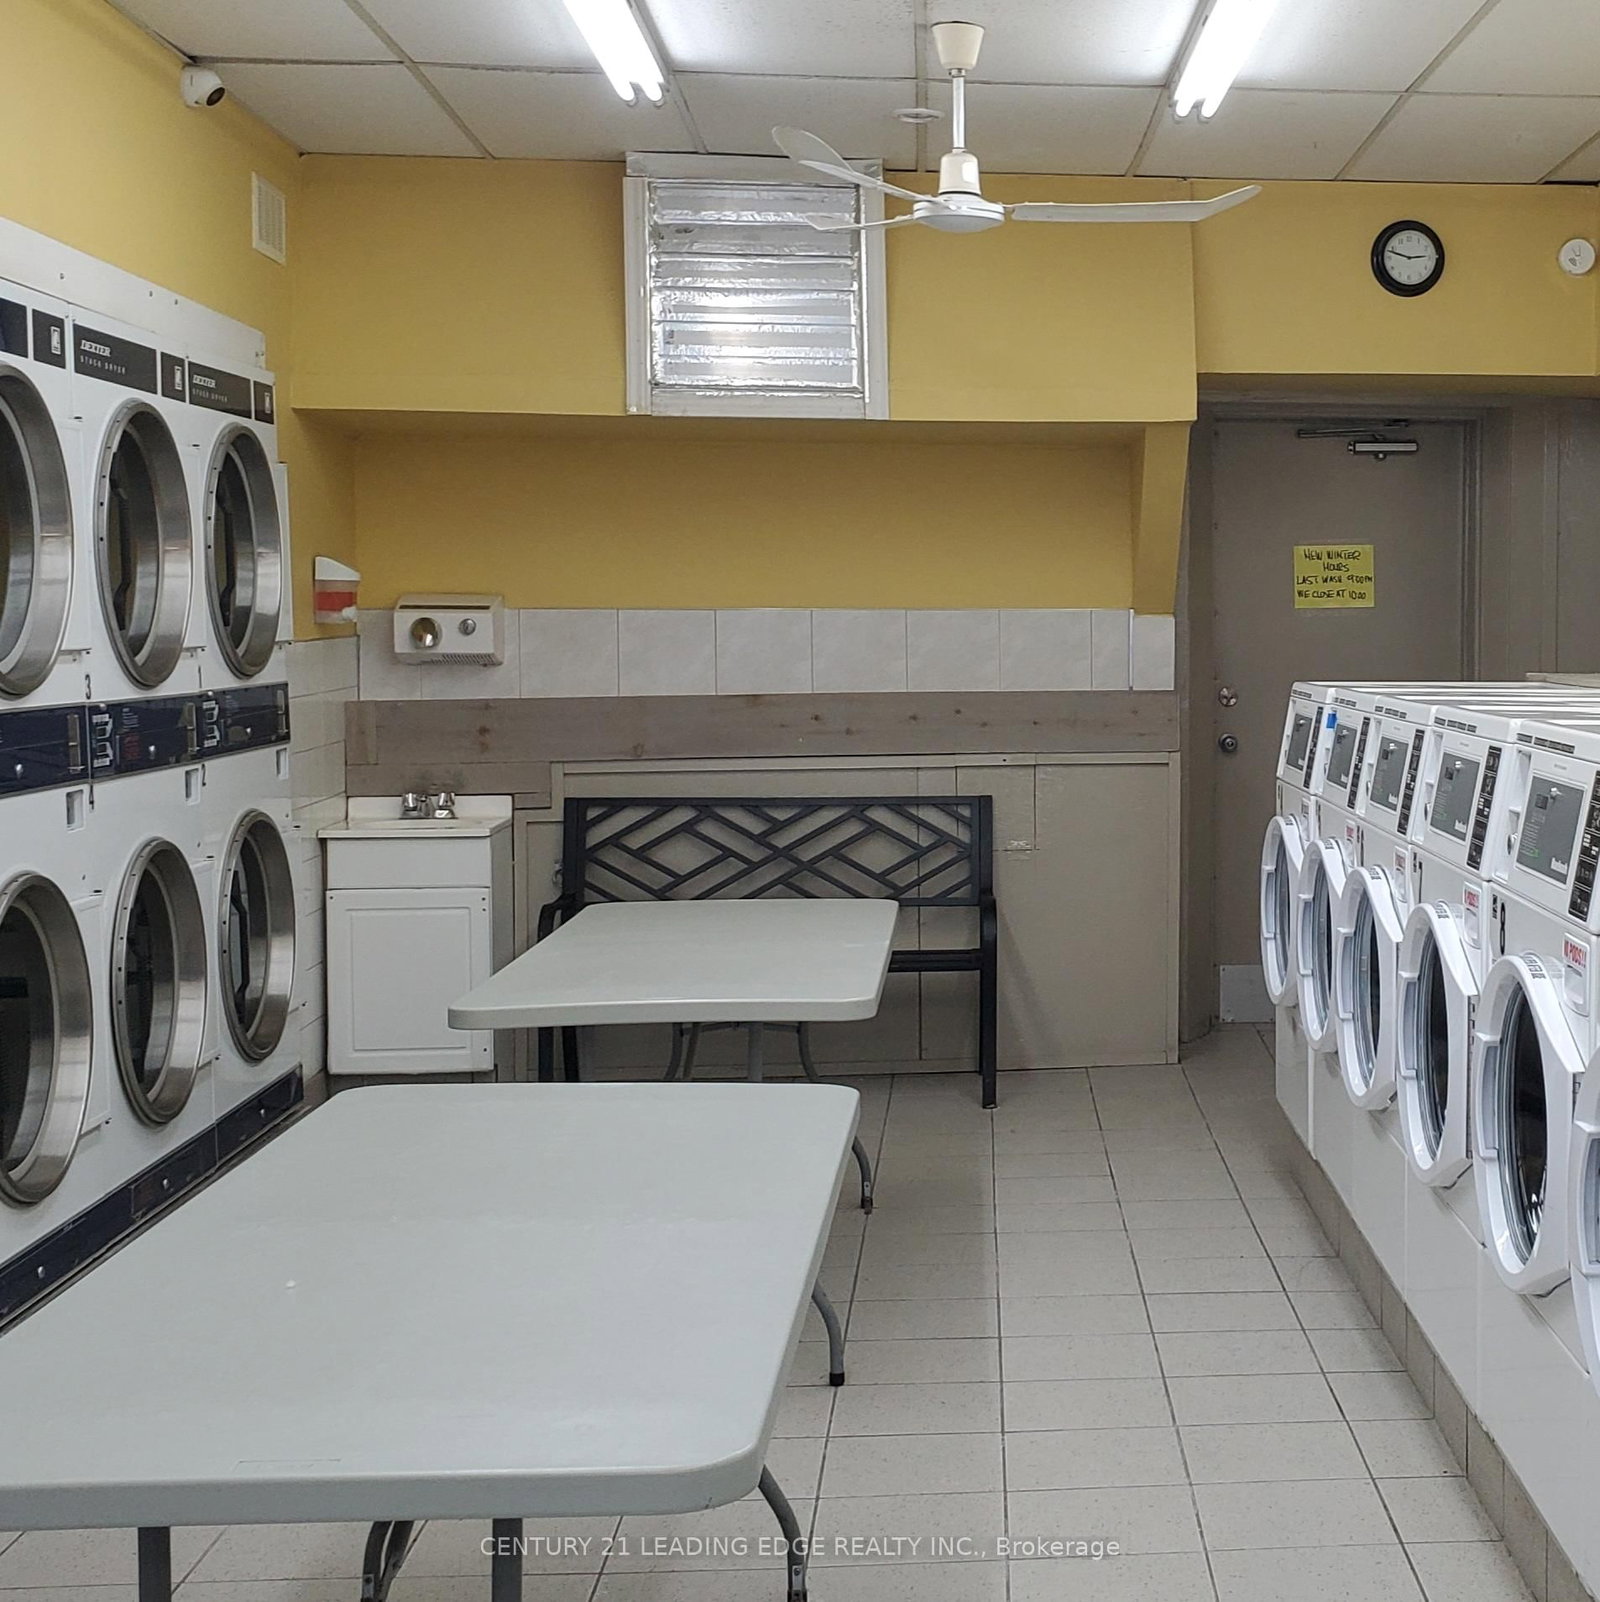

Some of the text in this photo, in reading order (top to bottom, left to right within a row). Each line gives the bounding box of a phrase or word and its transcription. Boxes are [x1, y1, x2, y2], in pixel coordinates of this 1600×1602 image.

[80, 340, 111, 357] DEXTER
[1304, 548, 1361, 561] NEW WINTER
[1323, 562, 1350, 572] HOURS
[1296, 575, 1319, 585] LAST
[1322, 575, 1343, 584] WASH
[1297, 589, 1311, 598] WE
[1312, 589, 1334, 599] CLOSE
[1335, 588, 1346, 598] AT
[85, 674, 91, 700] 3
[1500, 903, 1506, 955] 8
